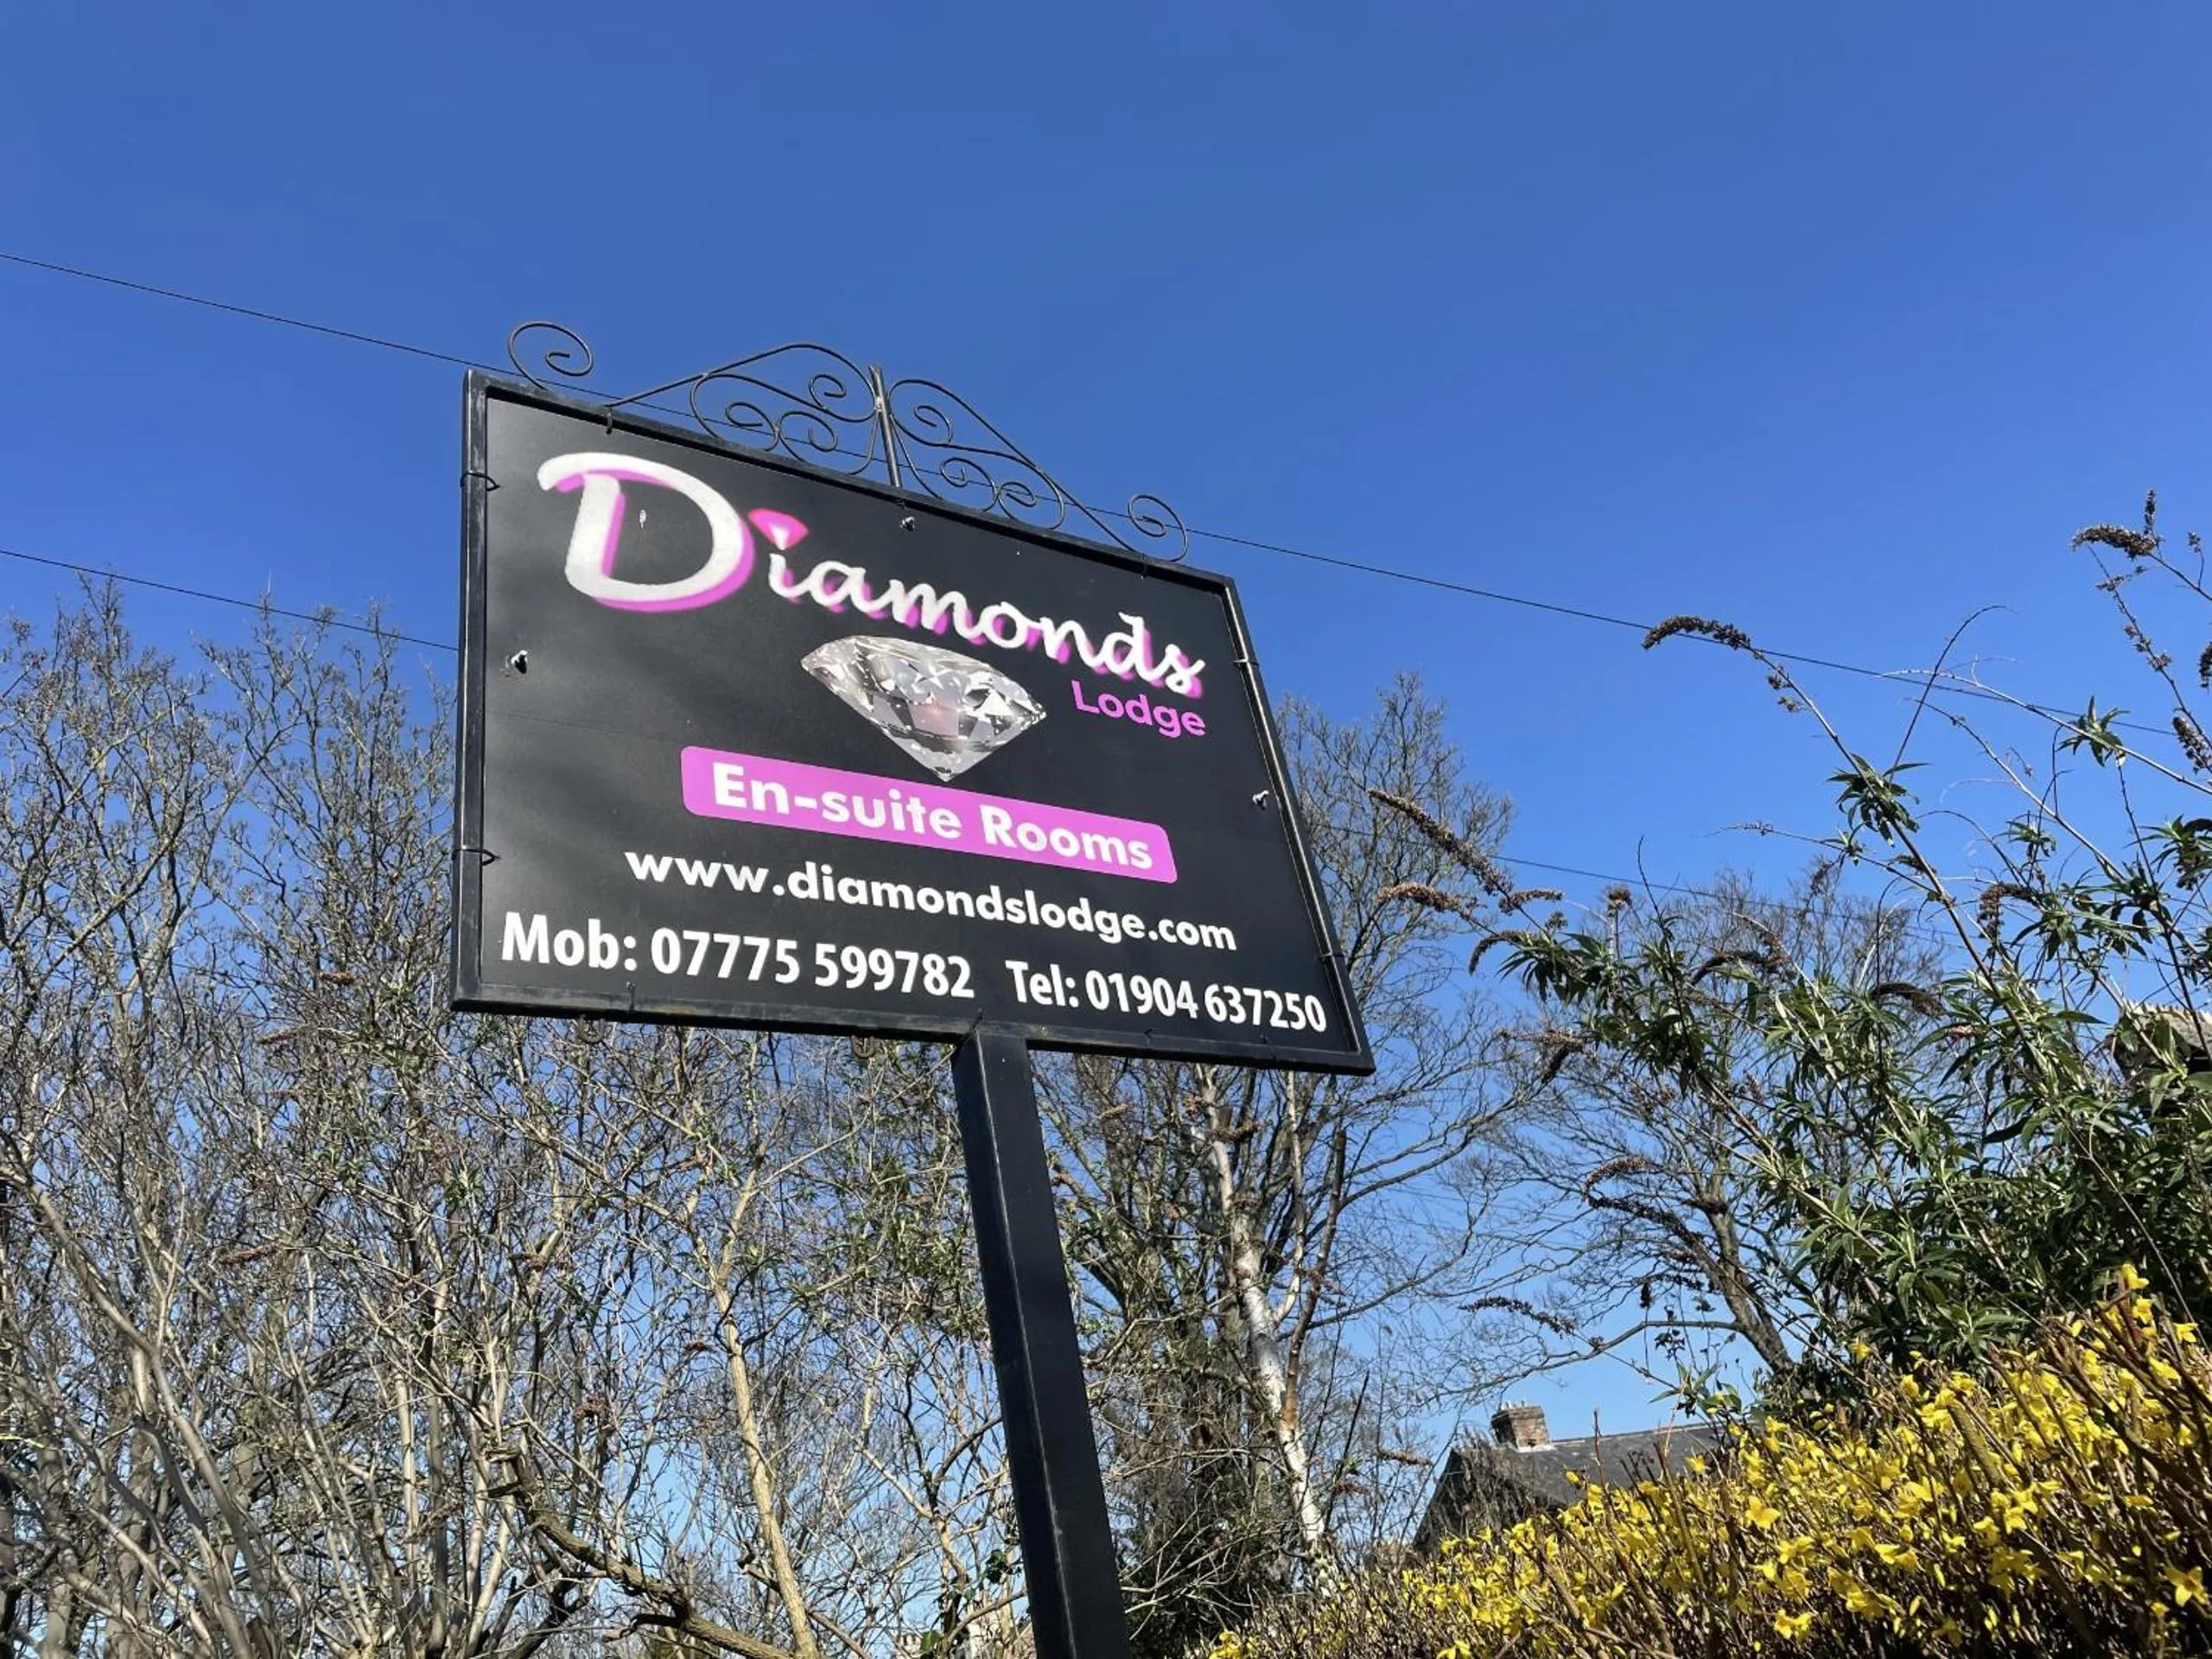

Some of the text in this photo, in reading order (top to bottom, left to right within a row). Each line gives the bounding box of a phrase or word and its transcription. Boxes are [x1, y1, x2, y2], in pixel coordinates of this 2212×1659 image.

[537, 451, 1207, 698] Diamonds
[1072, 681, 1206, 737] Lodge
[712, 762, 1153, 871] En-suite Rooms
[625, 851, 1236, 950] www.diamondslodge.com
[501, 911, 1327, 1033] Mob: 07775 599782 Tel: 01904 637250
